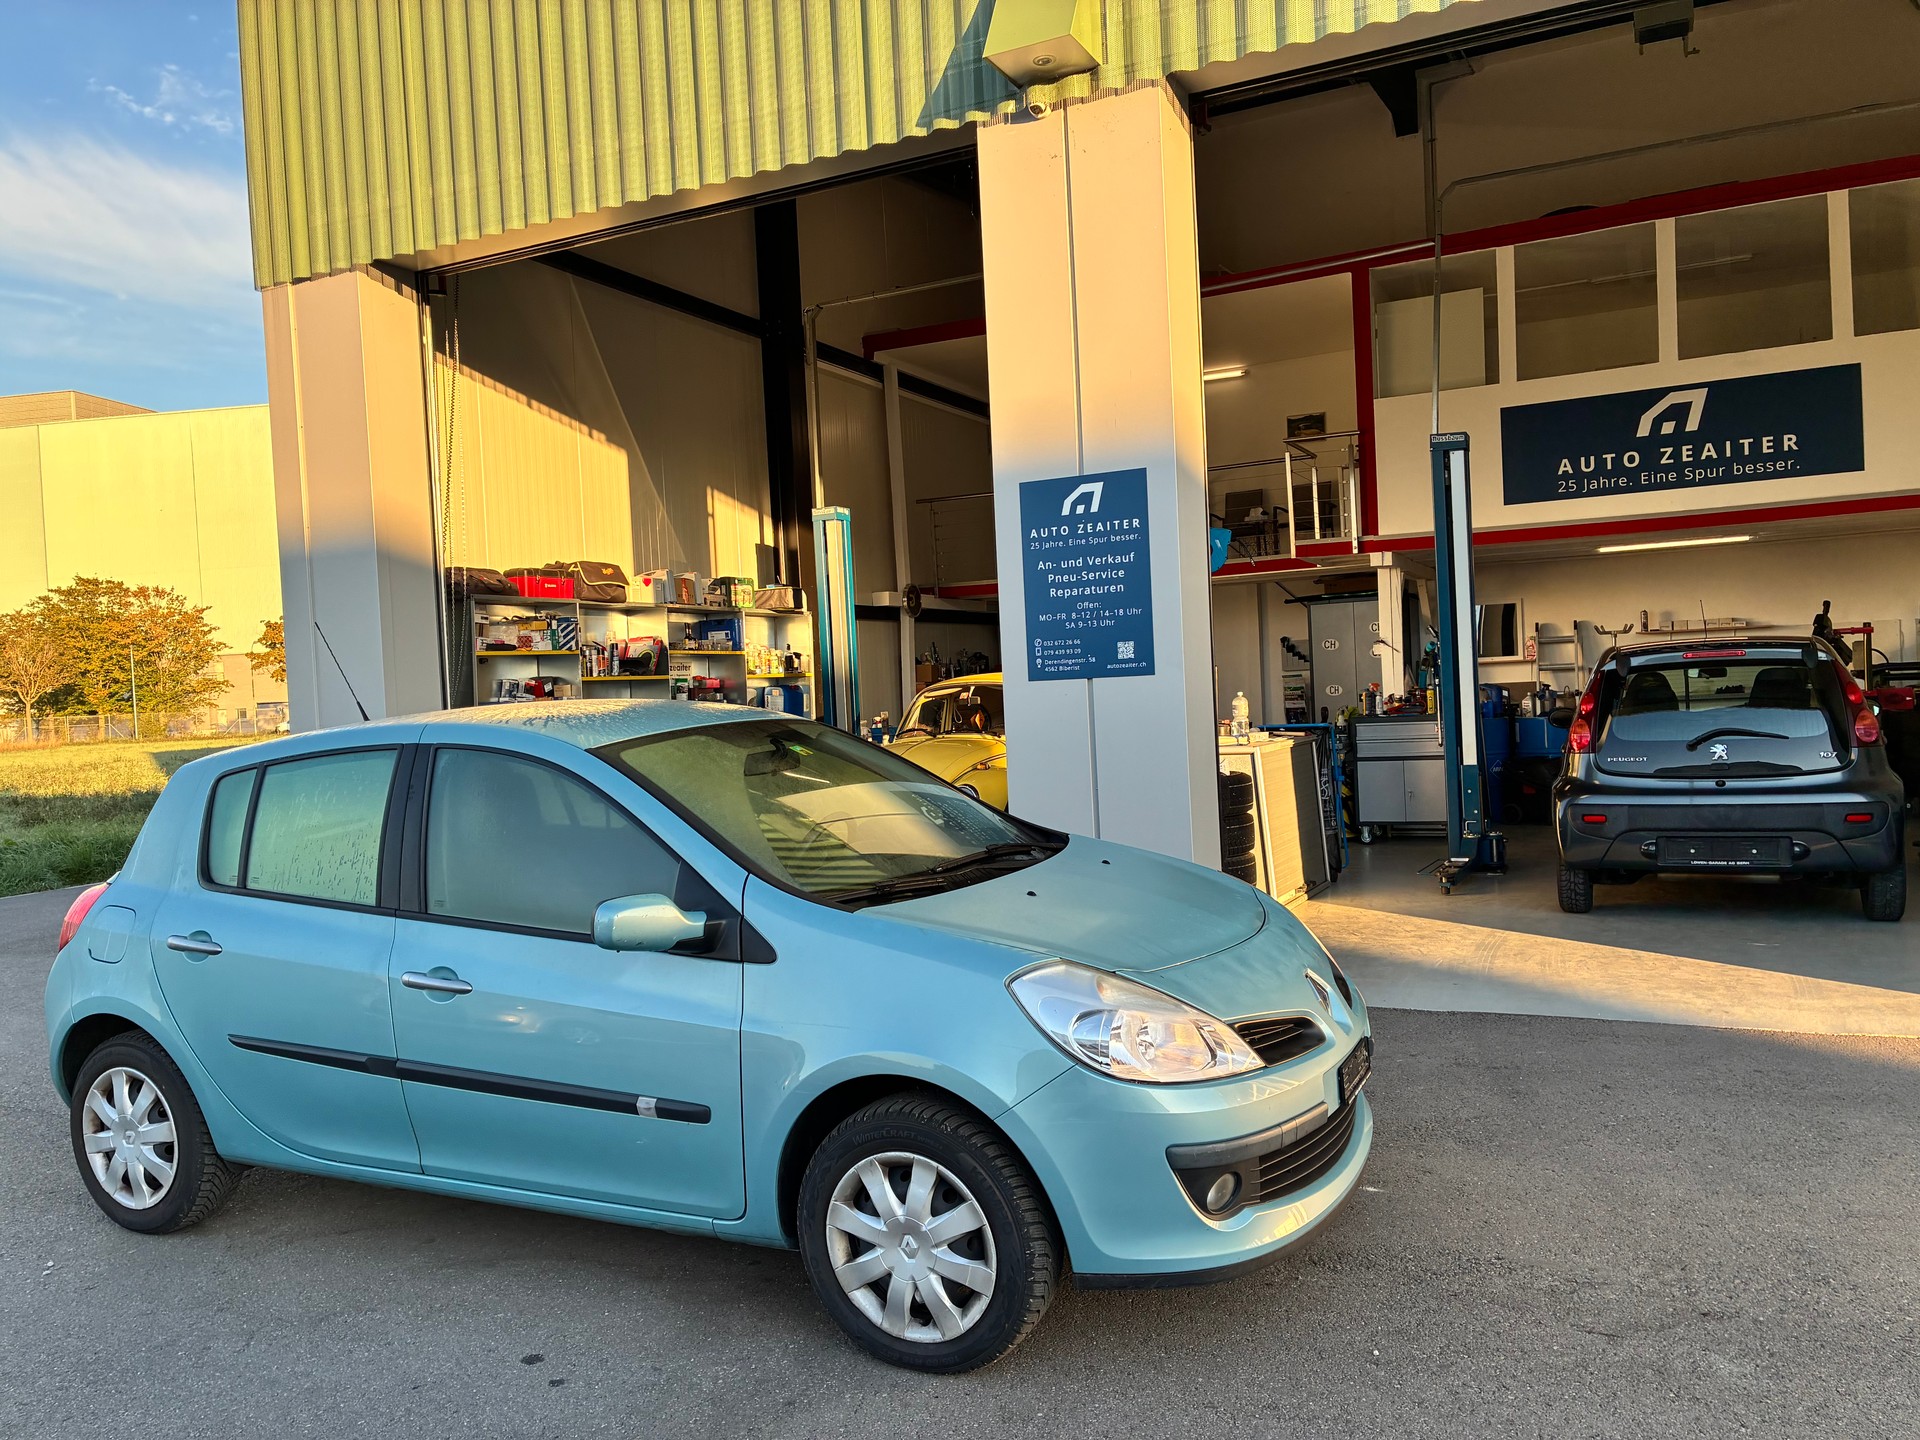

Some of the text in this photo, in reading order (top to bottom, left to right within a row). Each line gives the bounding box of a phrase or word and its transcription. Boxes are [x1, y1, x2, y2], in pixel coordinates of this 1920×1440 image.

[1557, 433, 1800, 475] AUTO ZEAITER
[1557, 458, 1801, 494] 25 Jahre. Eine Spur besser.
[1030, 518, 1141, 539] AUTO ZEAITER
[1030, 532, 1142, 550] 25 Jahre. Eine Spur besser.
[1037, 551, 1136, 571] An- und Verkauf
[1048, 568, 1125, 584] Pneu-Service
[1050, 583, 1124, 599] Reparaturen
[1076, 601, 1102, 610] Offen:
[1126, 606, 1142, 616] Uhr
[1065, 621, 1076, 630] SA
[1100, 618, 1115, 628] Uhr
[1371, 622, 1380, 632] C
[1324, 640, 1336, 649] CH
[669, 662, 691, 672] zeaiter
[1059, 664, 1080, 672] Biberist
[1106, 661, 1147, 669] autozeaiter.ch
[1329, 685, 1340, 695] CH
[1819, 751, 1838, 759] 107
